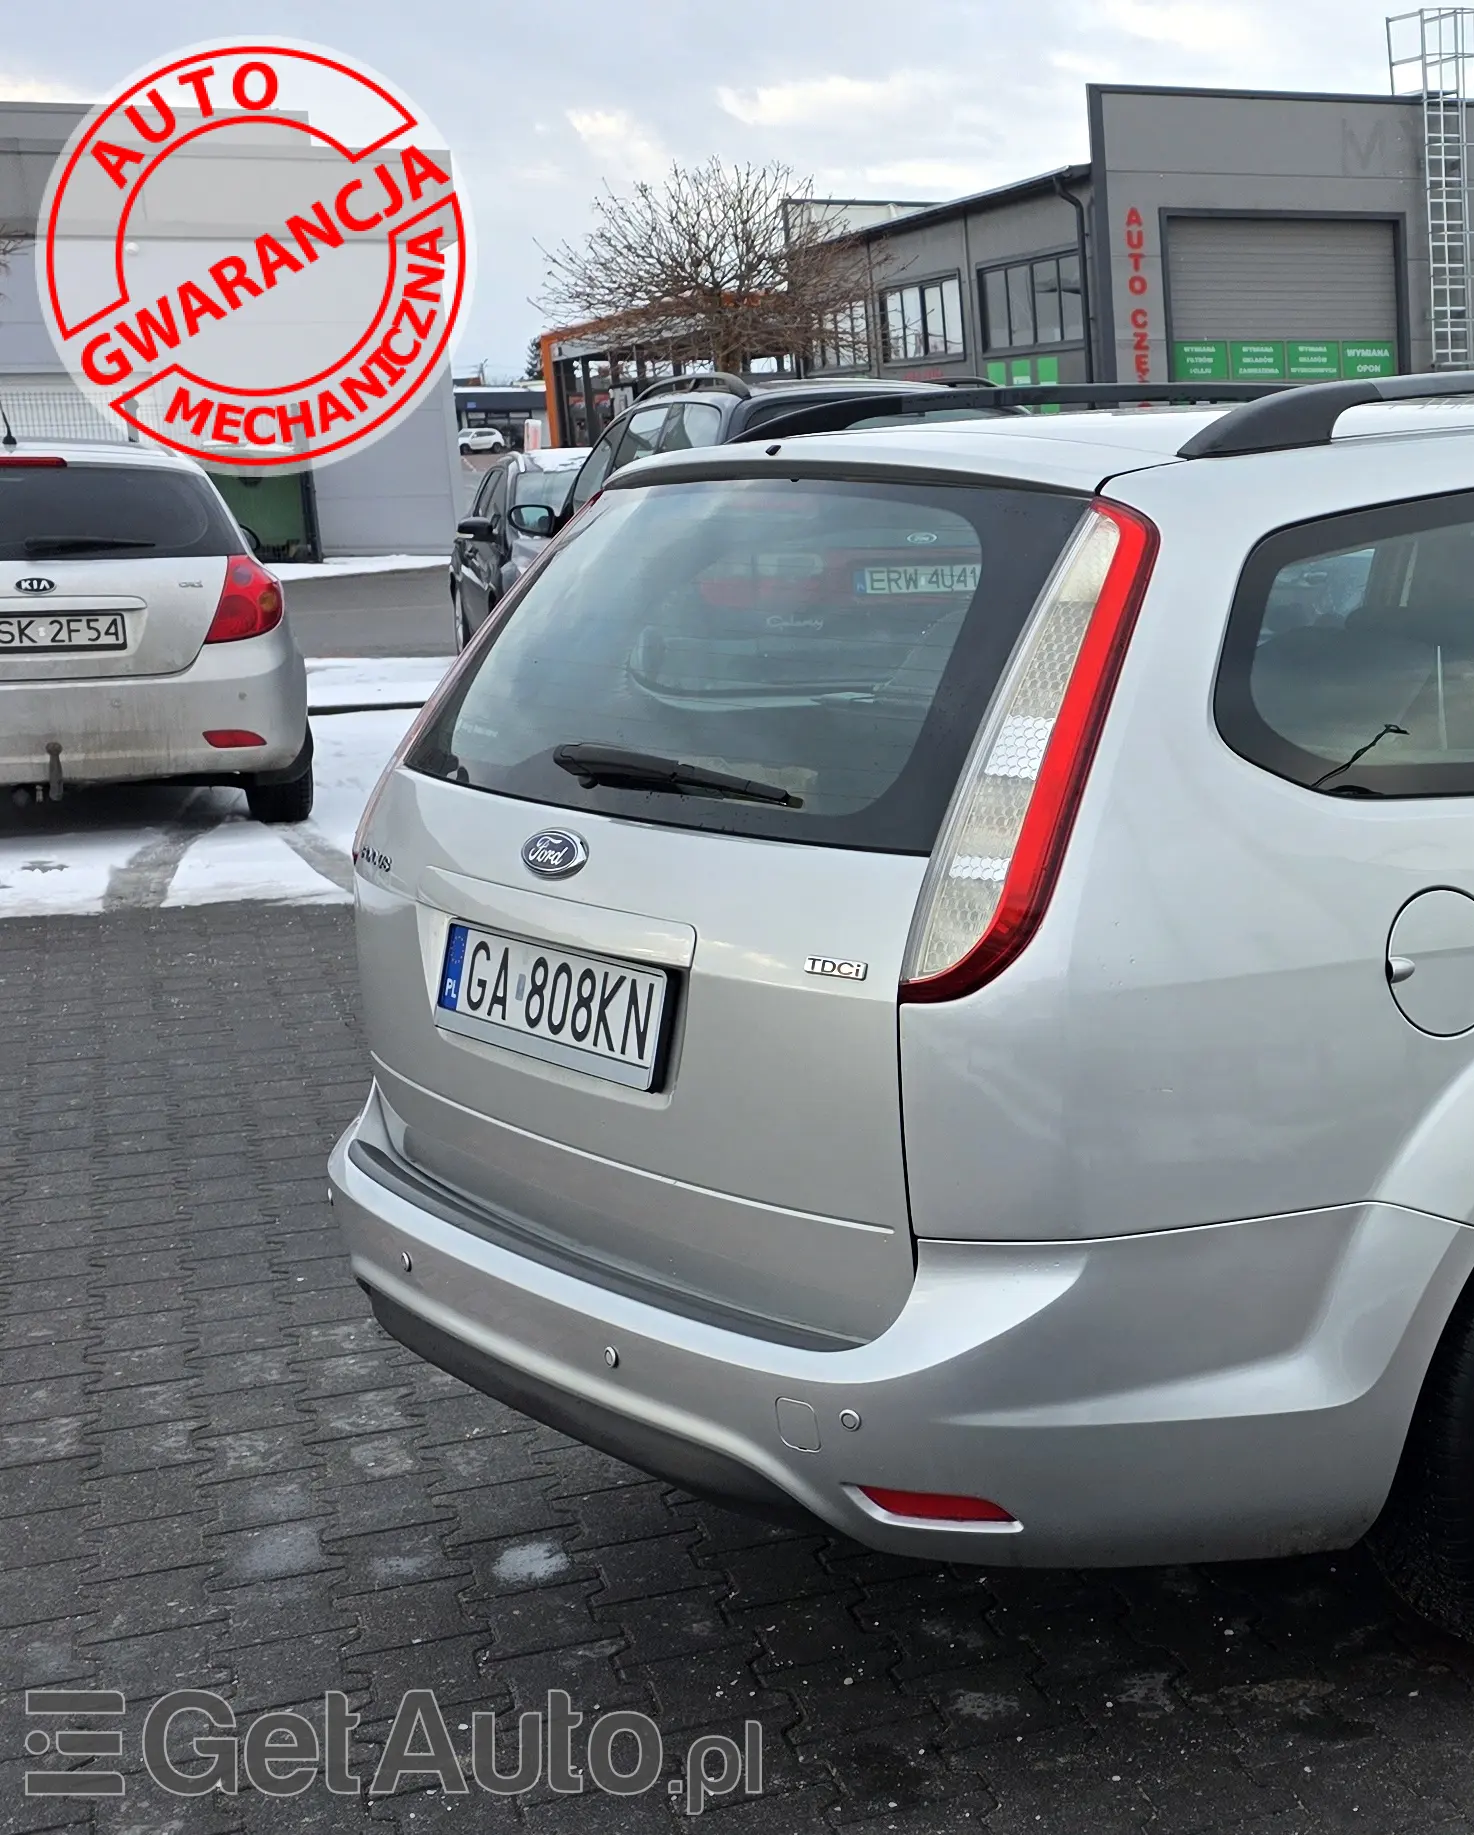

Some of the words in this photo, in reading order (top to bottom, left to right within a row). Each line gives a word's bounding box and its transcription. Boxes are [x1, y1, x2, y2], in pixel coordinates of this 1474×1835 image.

[1126, 207, 1148, 295] AUTO
[1346, 348, 1390, 357] WYMIANA
[1356, 364, 1381, 373] OPON
[21, 580, 50, 590] KIA
[869, 568, 918, 592] ERW
[49, 618, 120, 643] 2F54
[528, 836, 568, 866] Ford
[807, 957, 862, 977] TDCi
[445, 977, 457, 998] PL
[467, 940, 509, 1020] GA
[525, 956, 655, 1060] 808KN
